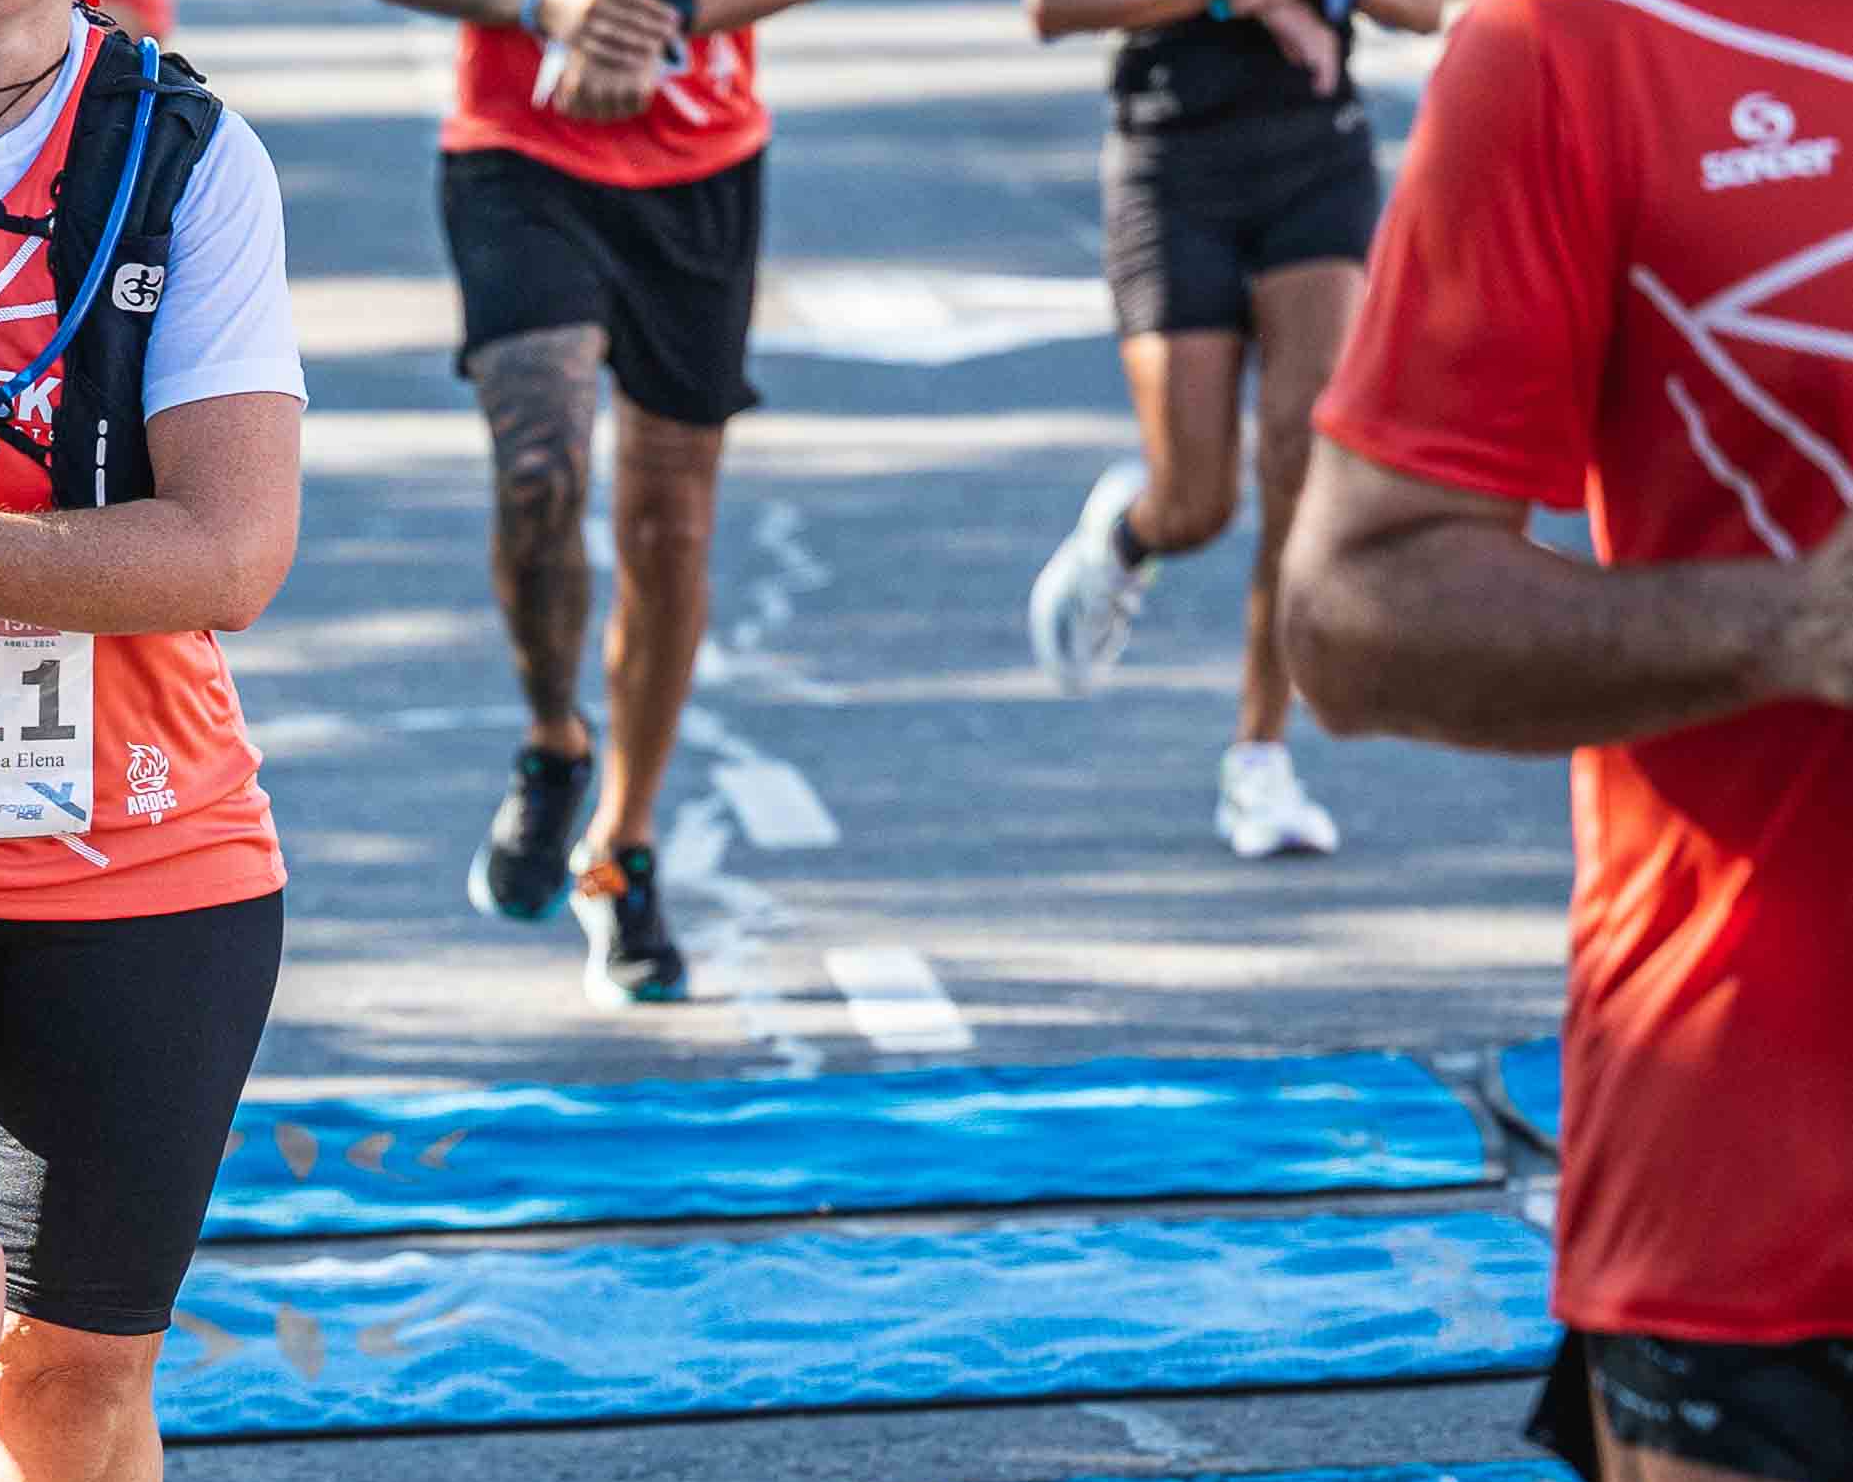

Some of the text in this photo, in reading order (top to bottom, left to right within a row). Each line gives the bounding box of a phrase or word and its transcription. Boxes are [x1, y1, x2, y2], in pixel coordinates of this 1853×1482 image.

[3, 639, 30, 648] ABRIL
[16, 751, 65, 768] Elena
[127, 789, 178, 815] ARDEC
